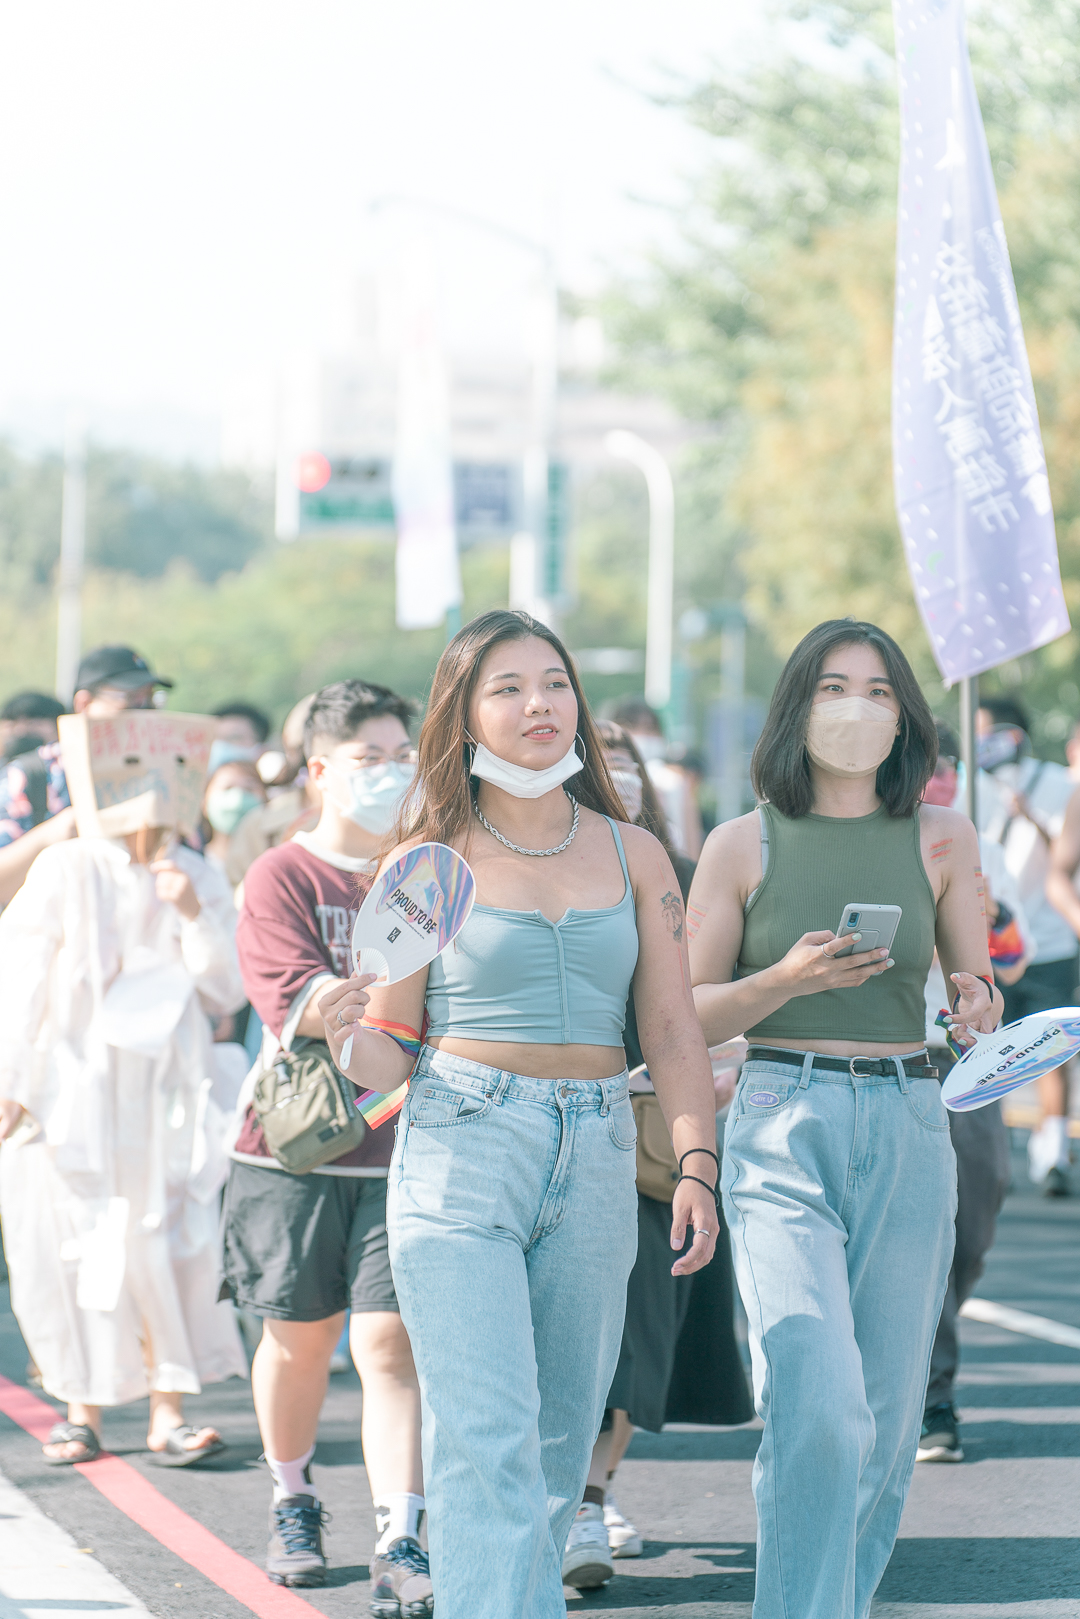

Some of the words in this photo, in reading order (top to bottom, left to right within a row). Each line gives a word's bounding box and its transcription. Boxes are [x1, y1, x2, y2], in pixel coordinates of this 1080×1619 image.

[390, 888, 418, 916] PROUD
[413, 908, 428, 925] TO
[422, 918, 437, 934] BE
[1015, 1028, 1061, 1059] PROUD
[996, 1060, 1016, 1073] TO
[977, 1072, 996, 1086] BE
